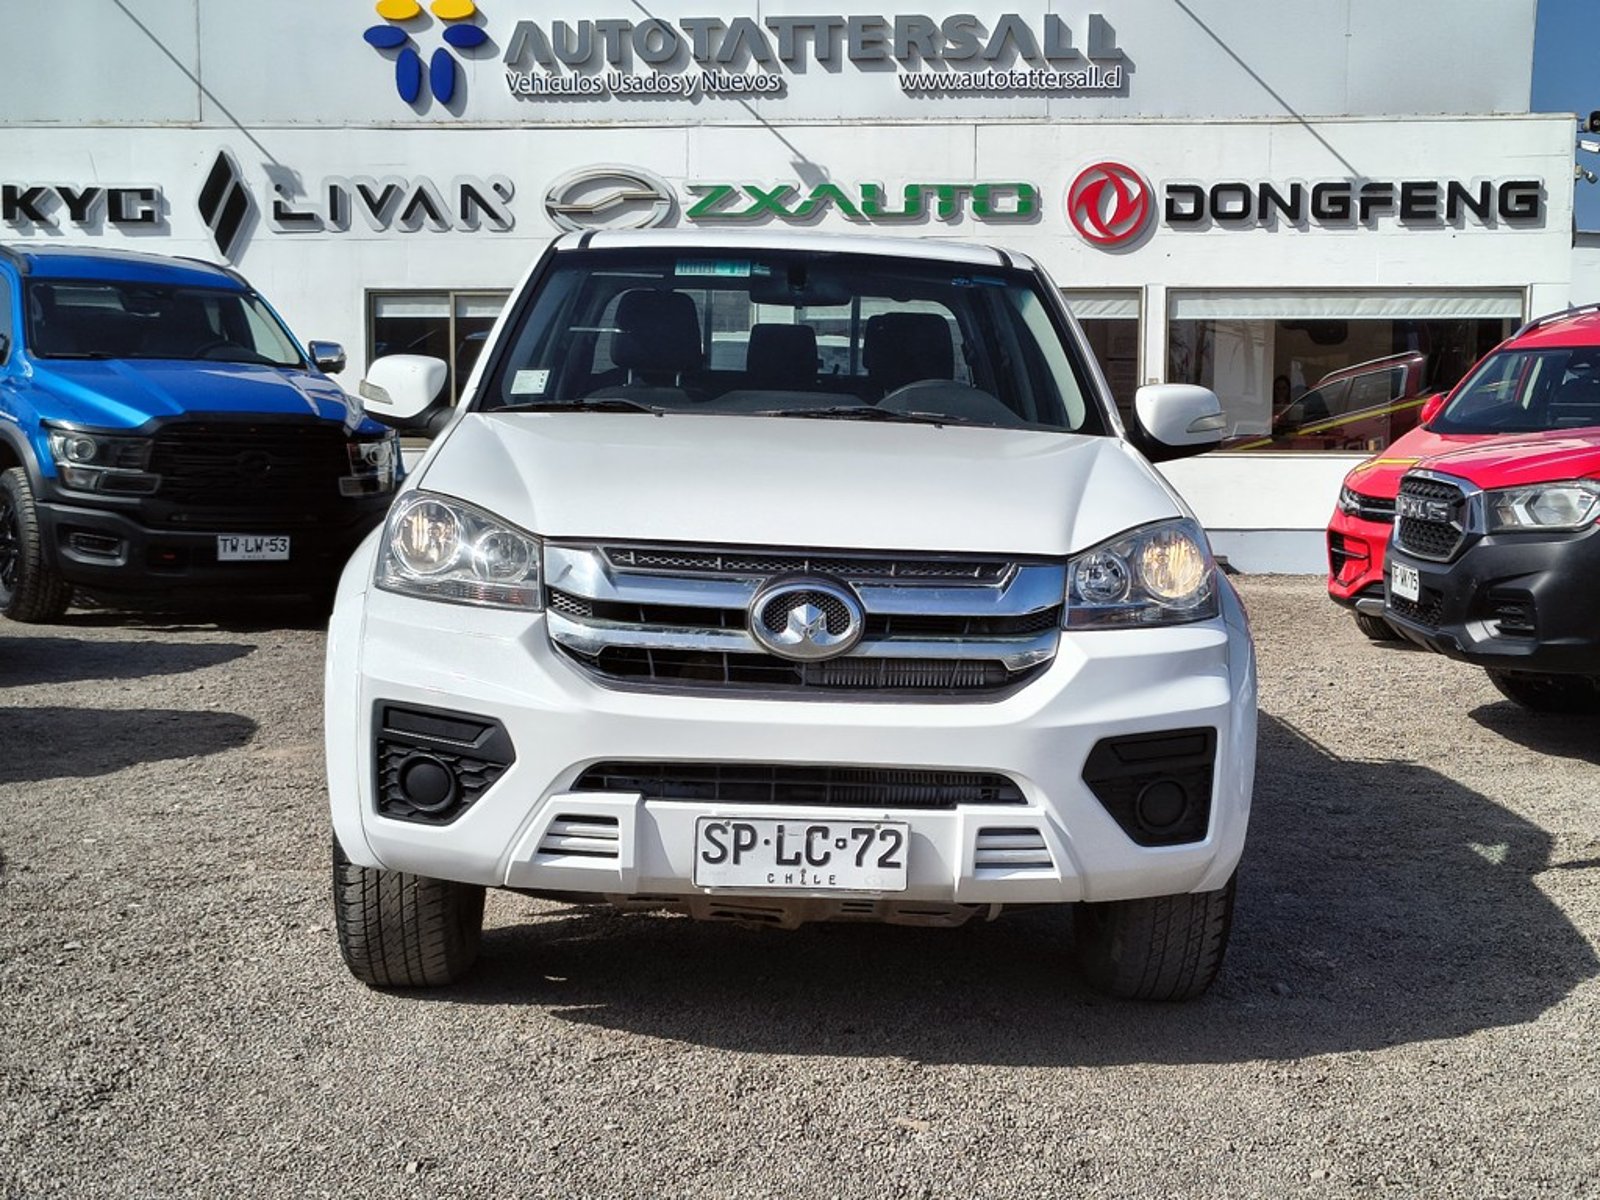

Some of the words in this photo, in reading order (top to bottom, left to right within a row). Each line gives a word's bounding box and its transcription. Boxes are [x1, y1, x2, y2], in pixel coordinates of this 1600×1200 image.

[504, 15, 1122, 64] AUTOTATTERSALL
[506, 71, 602, 94] Vehículos
[607, 72, 682, 93] Usados
[685, 75, 697, 96] y
[701, 71, 780, 92] Nuevos
[898, 66, 1121, 91] www.autotattersall.cl
[2, 184, 156, 222] KYC
[273, 183, 513, 222] LIVAN
[686, 183, 1036, 218] ZXAUTO
[1166, 180, 1540, 221] DONGFENG
[767, 872, 837, 885] CHILE
